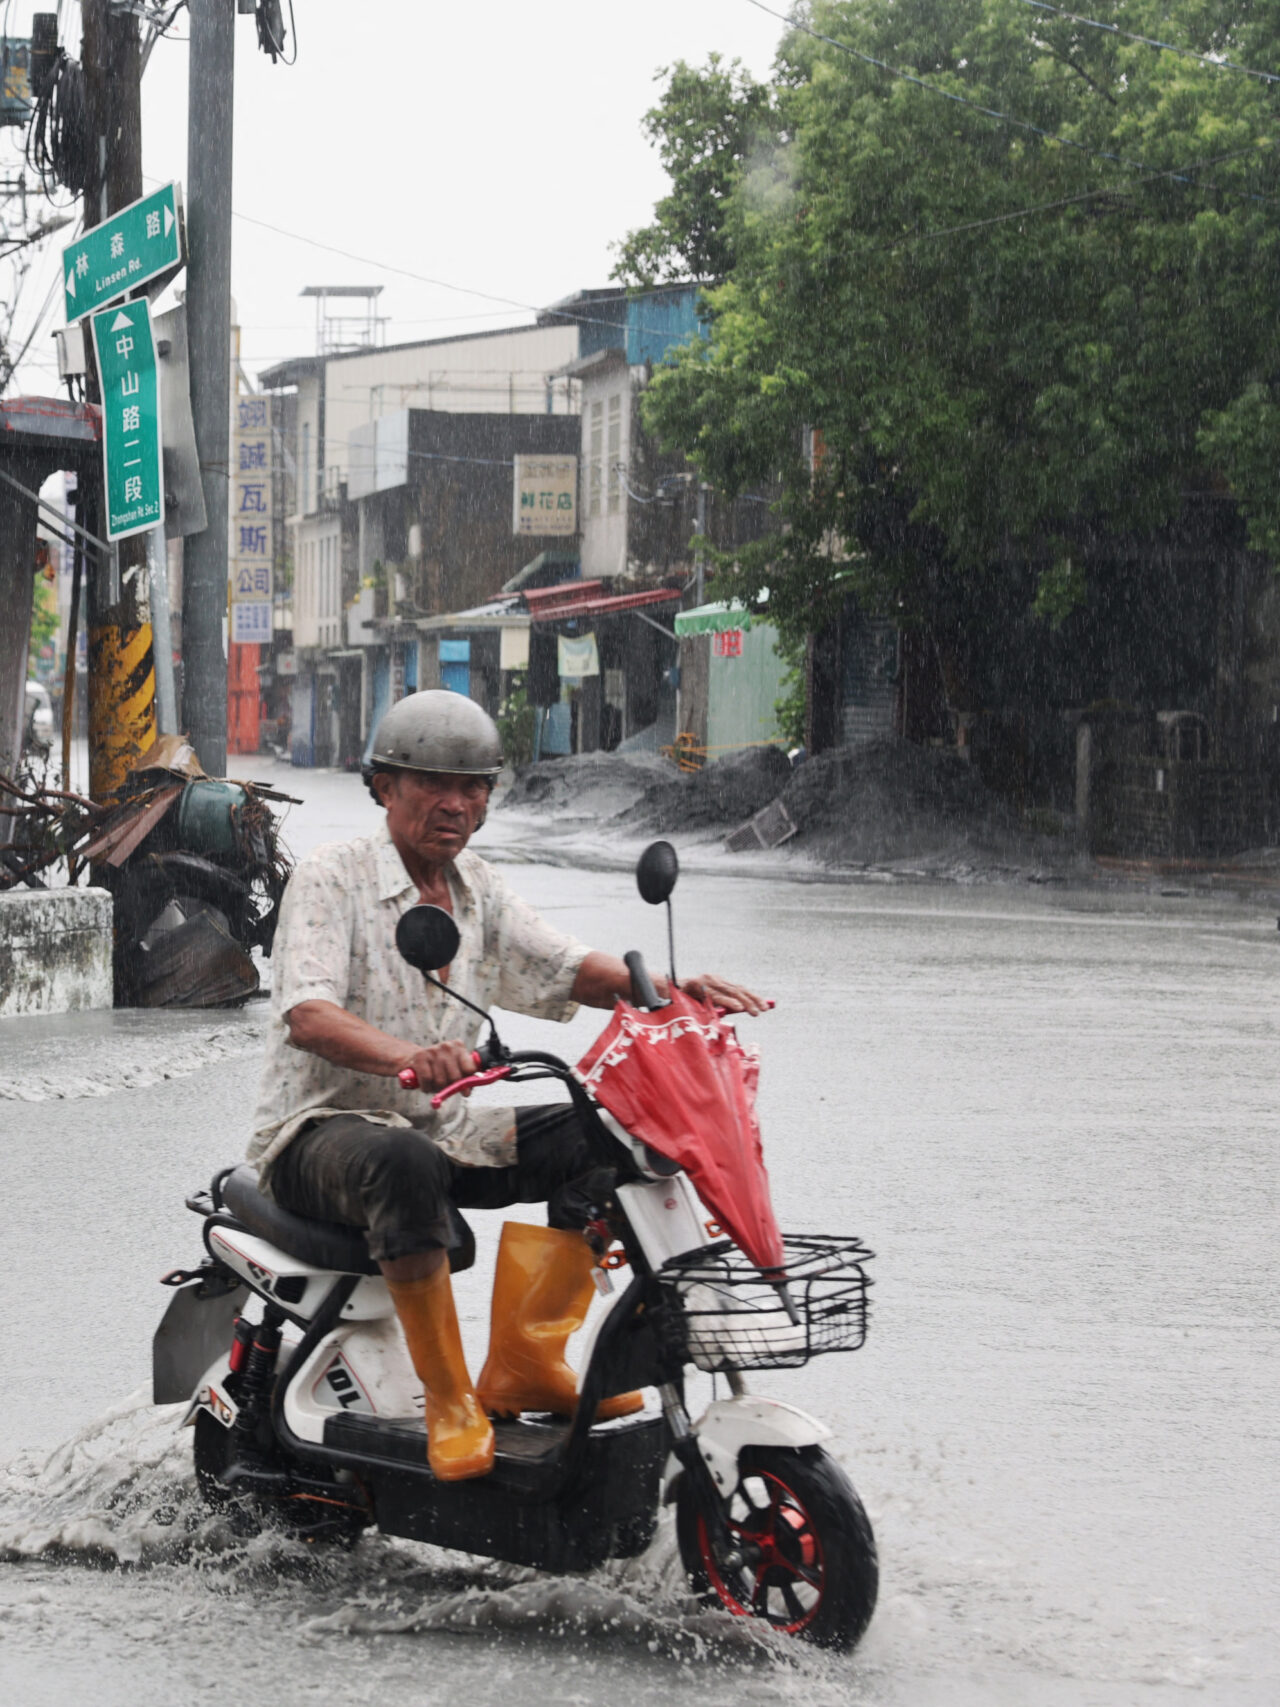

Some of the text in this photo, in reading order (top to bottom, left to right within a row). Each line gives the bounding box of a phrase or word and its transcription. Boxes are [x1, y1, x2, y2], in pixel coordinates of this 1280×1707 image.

[75, 211, 160, 280] 林森路
[96, 257, 142, 292] Linsen Rd.
[116, 335, 143, 504] 中山路二段
[521, 491, 572, 510] 鮮花店
[111, 510, 137, 527] Zhongshan
